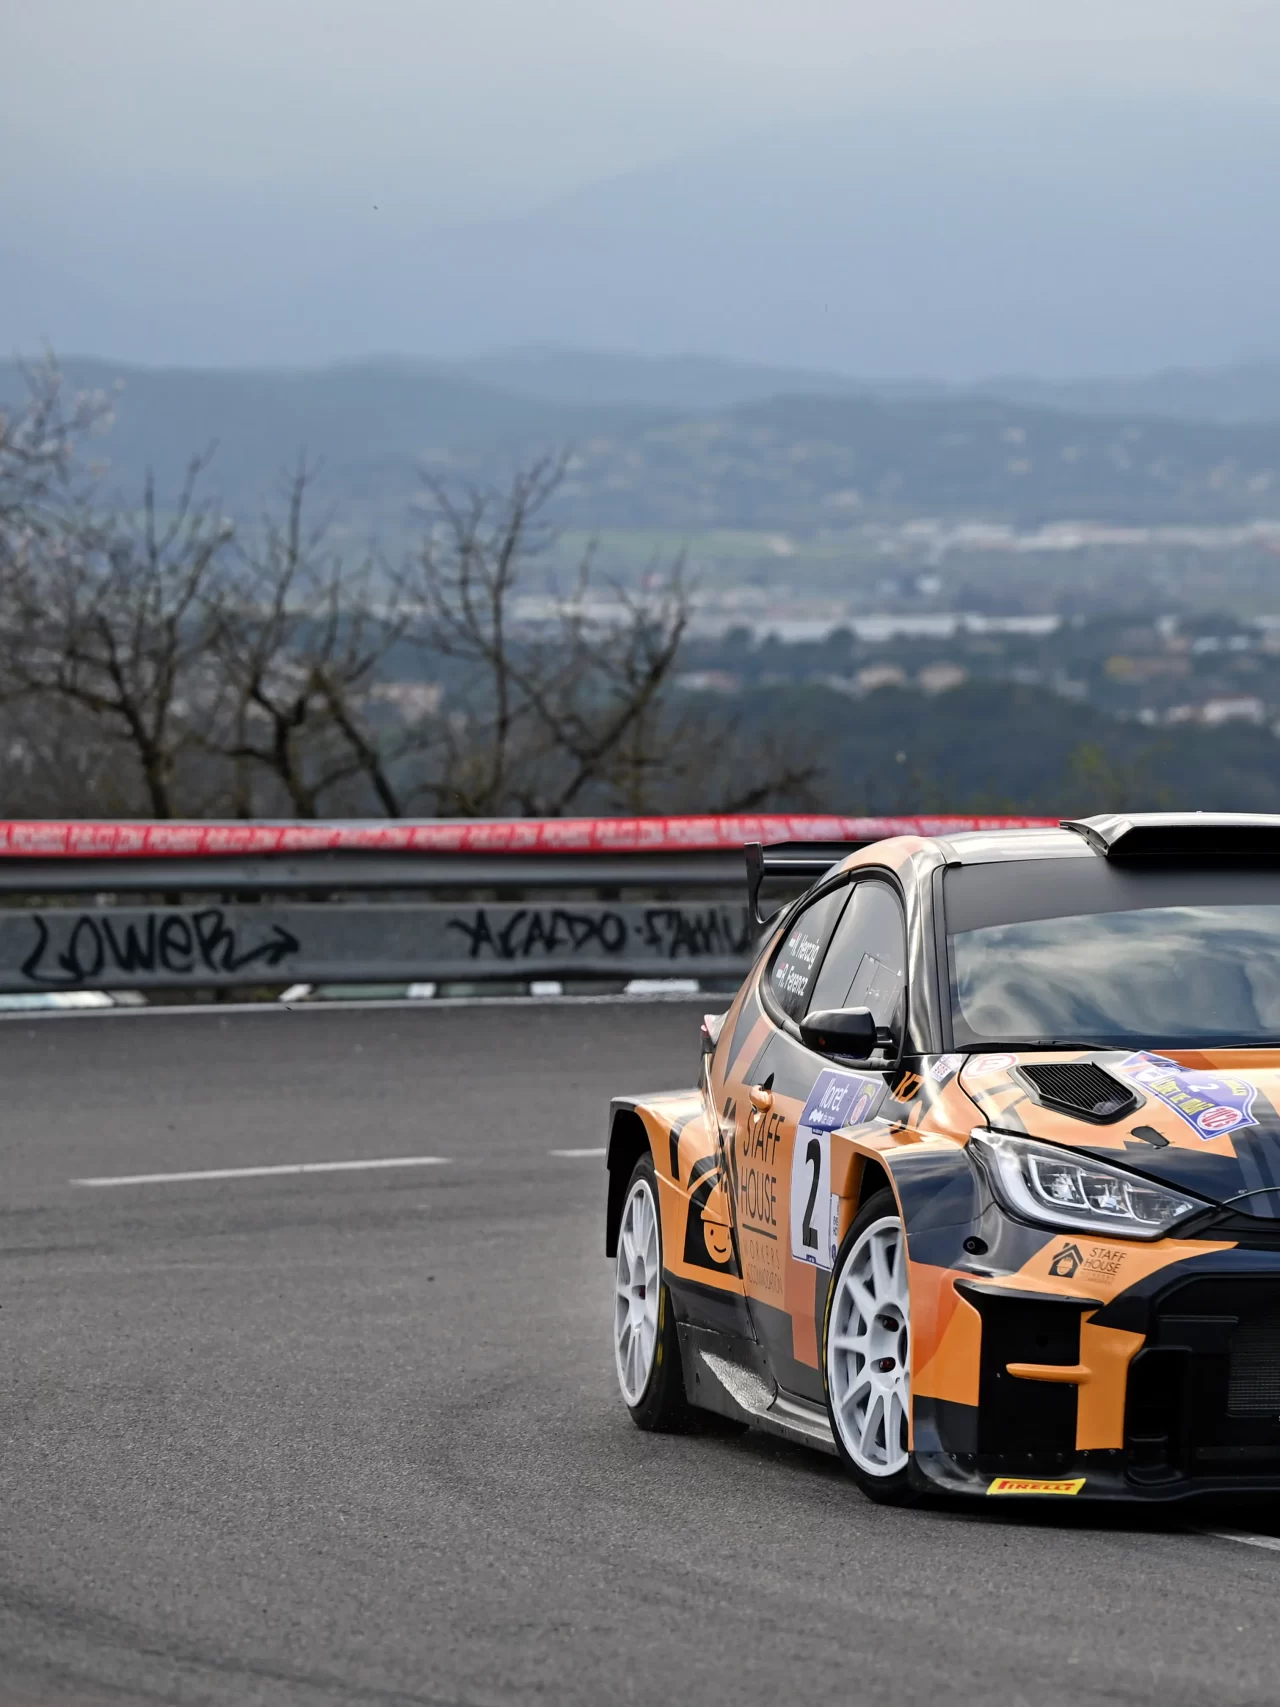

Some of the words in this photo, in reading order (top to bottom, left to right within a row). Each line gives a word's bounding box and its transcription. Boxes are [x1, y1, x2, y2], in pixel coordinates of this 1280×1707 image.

[819, 1077, 851, 1112] lloret
[743, 1107, 786, 1166] STAFF
[740, 1168, 777, 1227] HOUSE
[802, 1138, 821, 1251] 2
[1083, 1258, 1122, 1274] HOUSE
[1089, 1247, 1127, 1262] STAFF
[997, 1480, 1076, 1491] PIRELLI
